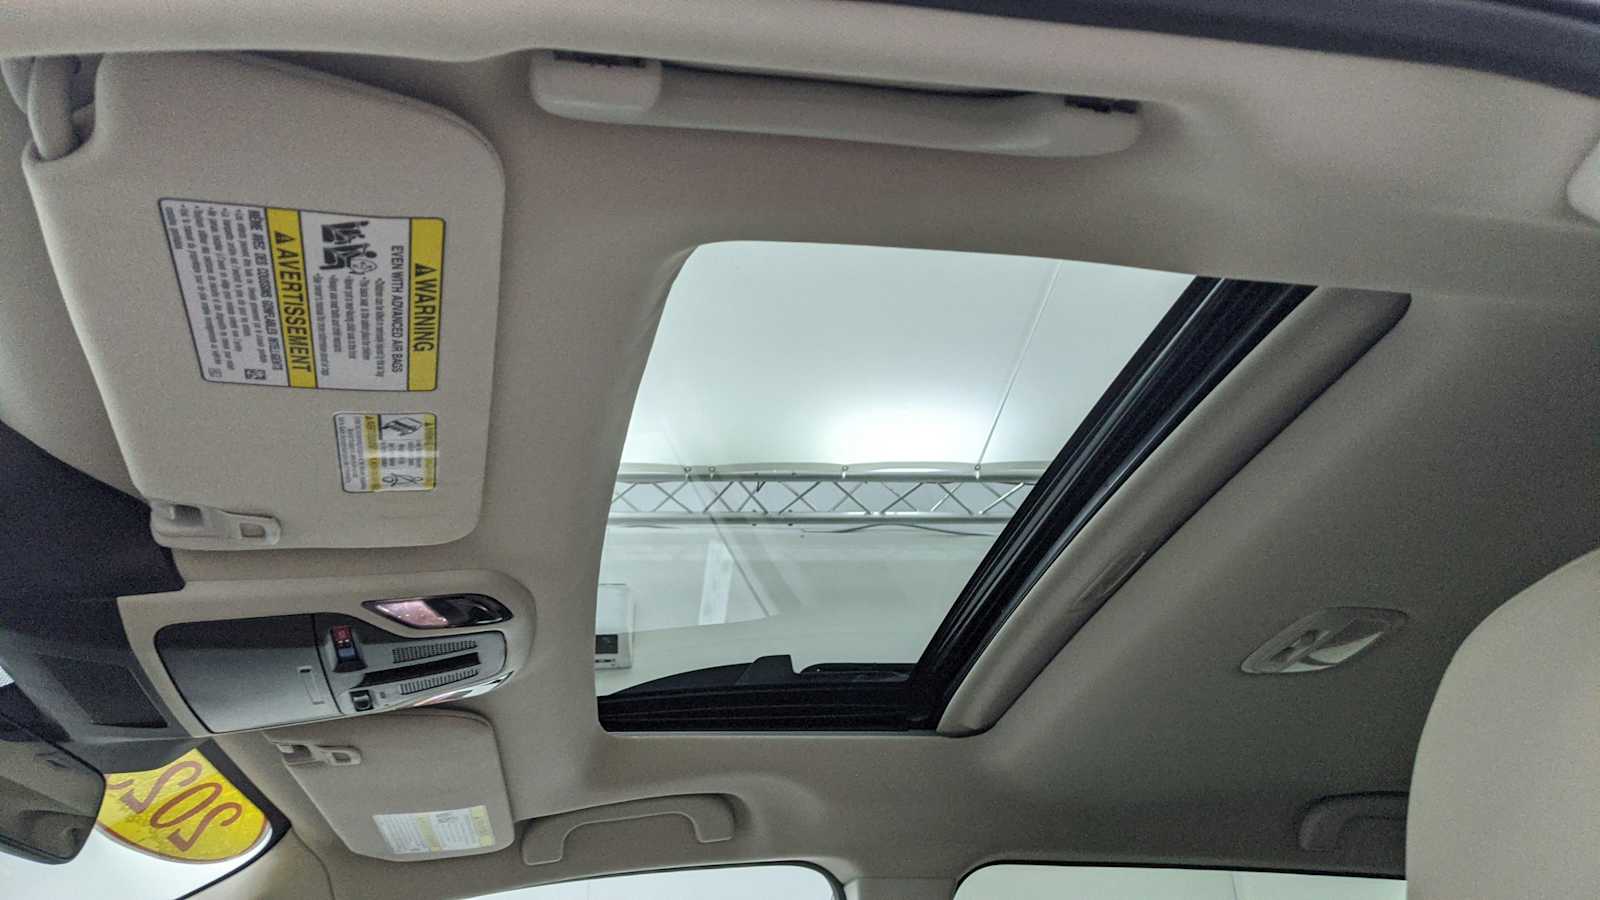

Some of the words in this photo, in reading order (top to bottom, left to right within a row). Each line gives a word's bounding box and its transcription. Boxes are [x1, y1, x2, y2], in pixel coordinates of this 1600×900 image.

[392, 246, 404, 269] EVEN
[392, 272, 404, 293] WITH
[276, 248, 311, 372] AVERTISSEMENT
[392, 294, 404, 338] ADVANCED
[414, 278, 438, 352] WARNING
[392, 340, 403, 351] AIR
[392, 353, 403, 373] BAGS
